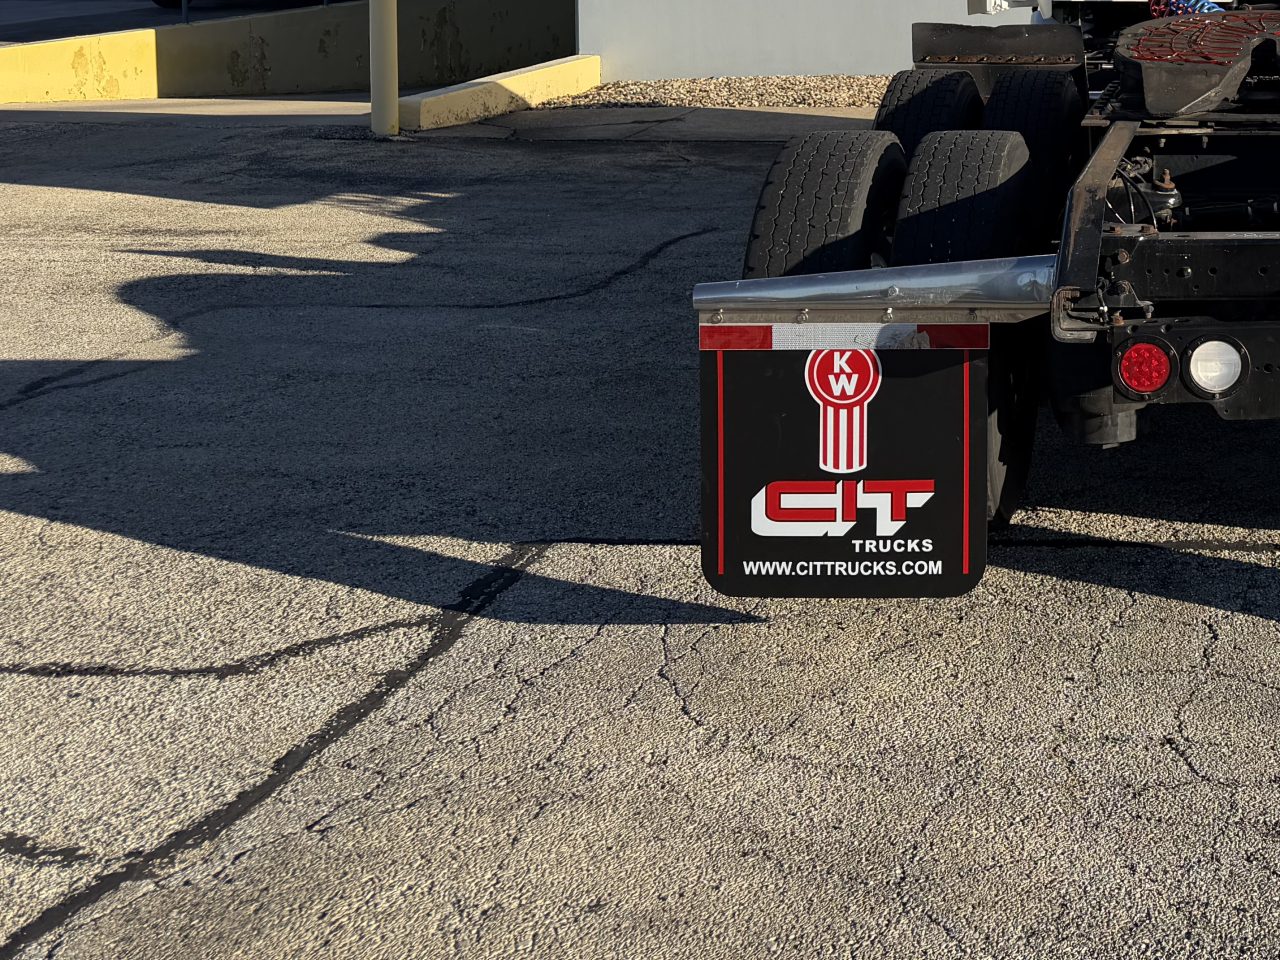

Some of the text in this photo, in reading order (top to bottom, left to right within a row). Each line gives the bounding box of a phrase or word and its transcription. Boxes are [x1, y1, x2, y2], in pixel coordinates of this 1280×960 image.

[833, 351, 853, 373] K
[828, 374, 858, 396] W
[751, 480, 935, 536] CIT
[852, 539, 933, 553] TRUCKS
[743, 560, 942, 576] WWW.CITTRUCKS.COM
